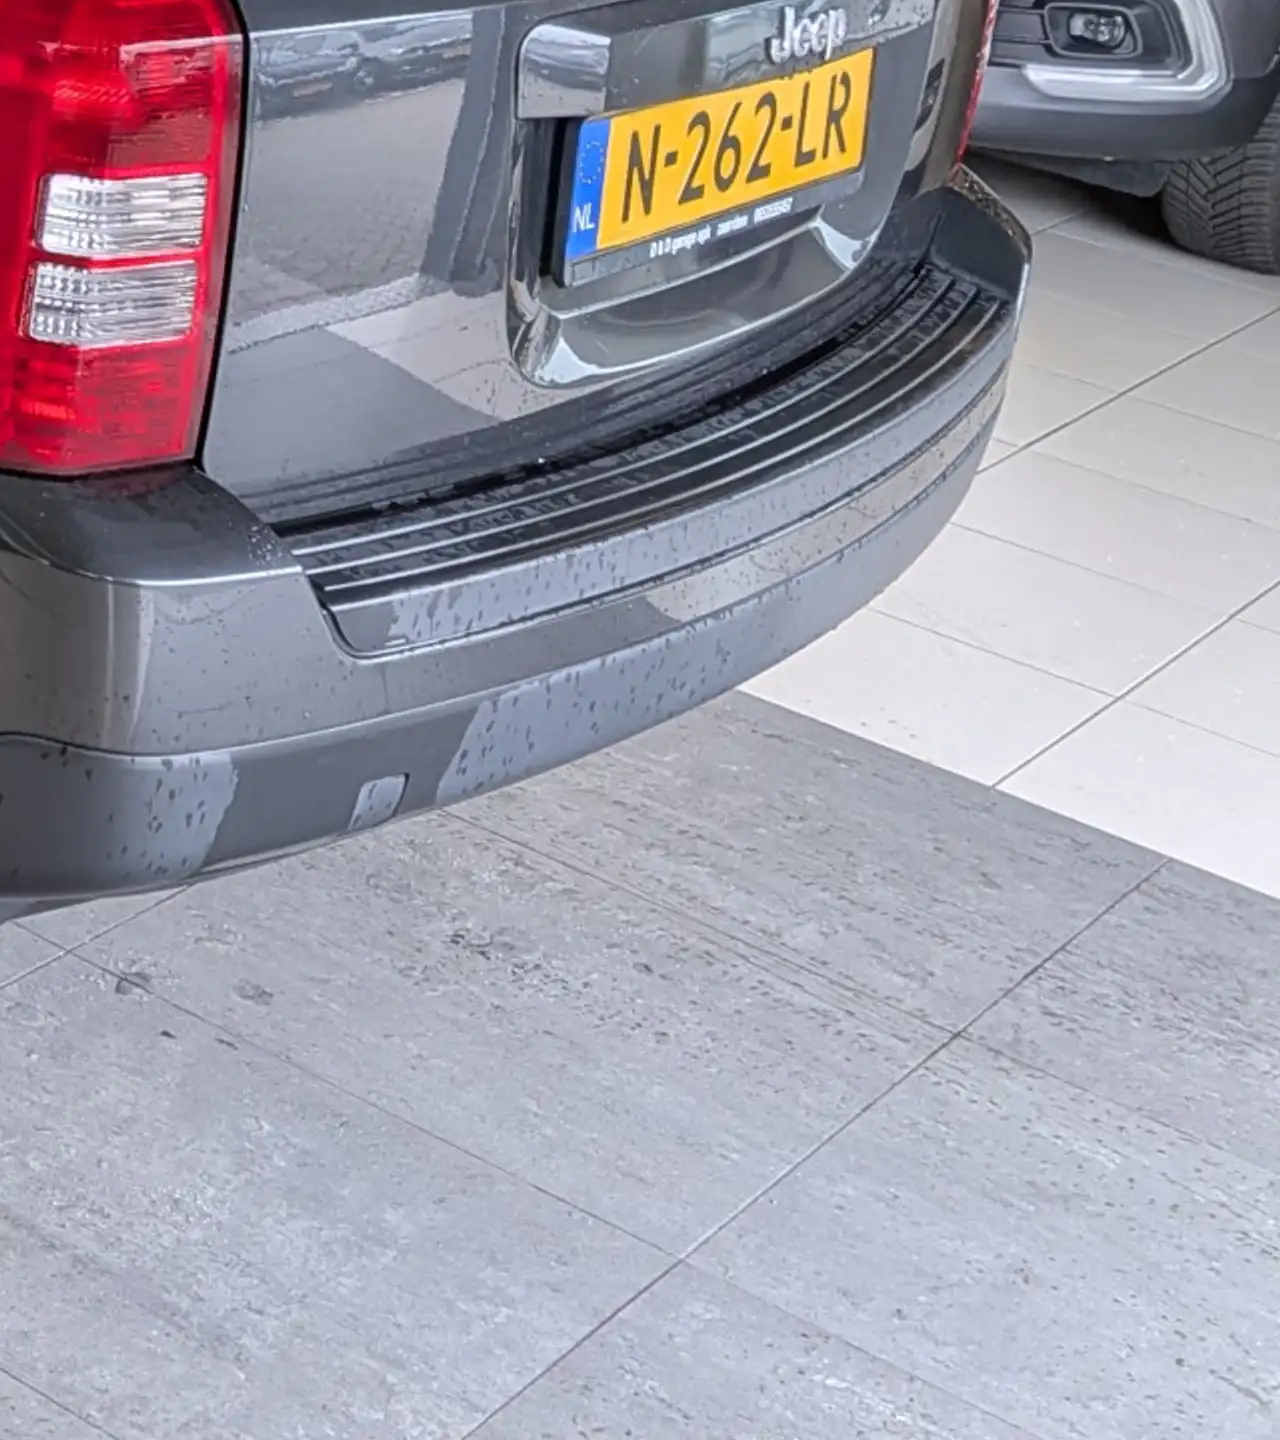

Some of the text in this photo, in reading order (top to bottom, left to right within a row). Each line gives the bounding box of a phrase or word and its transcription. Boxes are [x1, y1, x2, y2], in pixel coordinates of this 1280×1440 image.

[770, 6, 846, 63] Jeep
[621, 71, 852, 224] N-262-LR
[572, 202, 596, 233] NL
